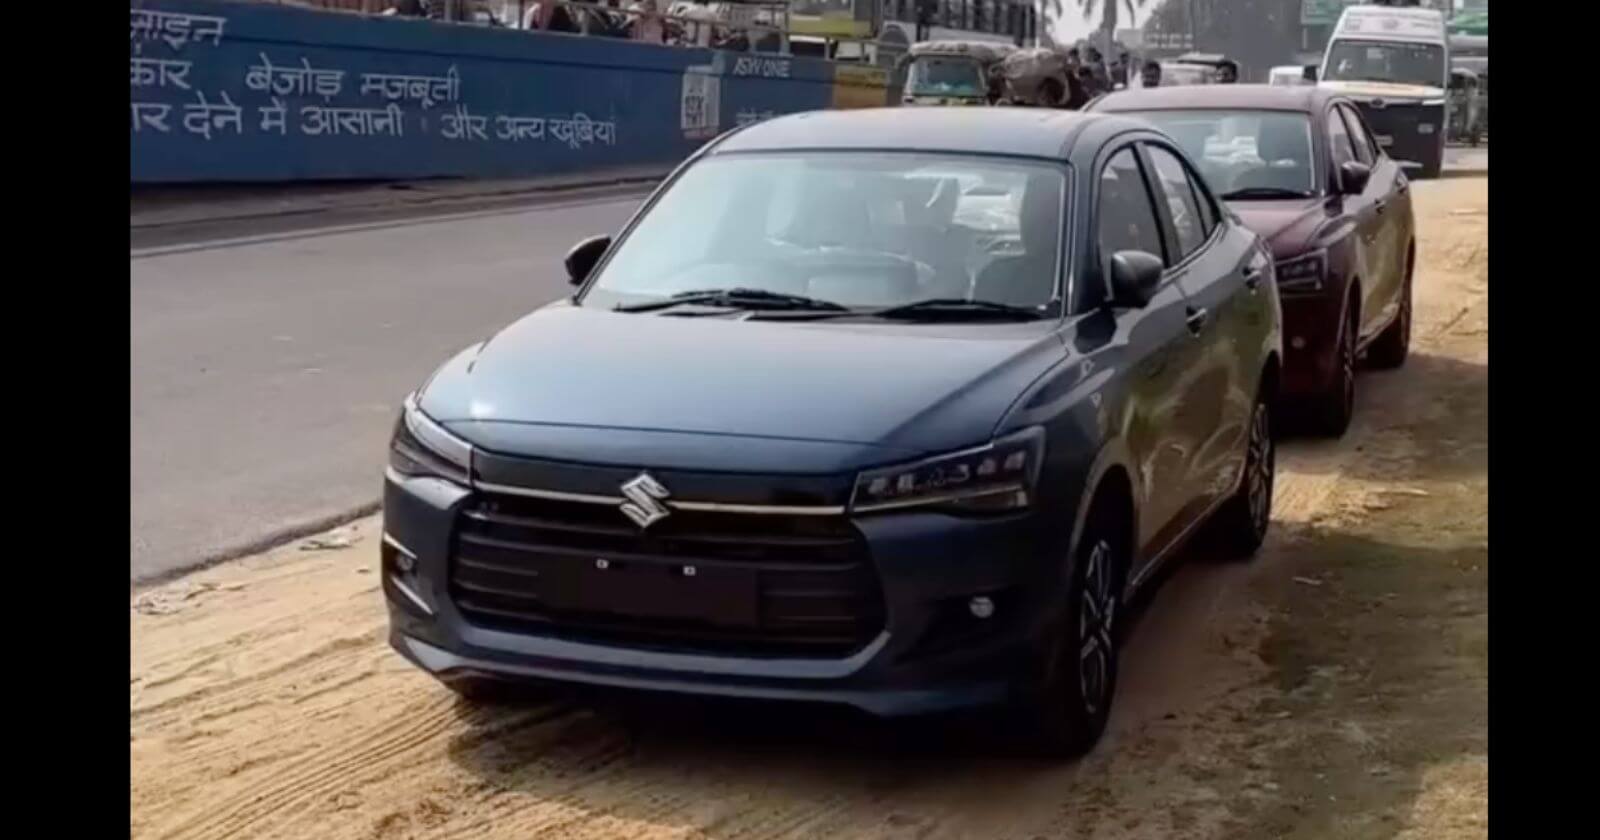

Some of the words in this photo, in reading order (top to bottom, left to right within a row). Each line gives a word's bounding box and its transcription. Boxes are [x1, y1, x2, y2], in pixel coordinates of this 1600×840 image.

[361, 64, 459, 108] मजबूती
[184, 90, 242, 139] देने
[259, 96, 287, 134] में
[301, 103, 403, 136] आसानी
[441, 104, 489, 140] और
[495, 115, 546, 141] अन्य
